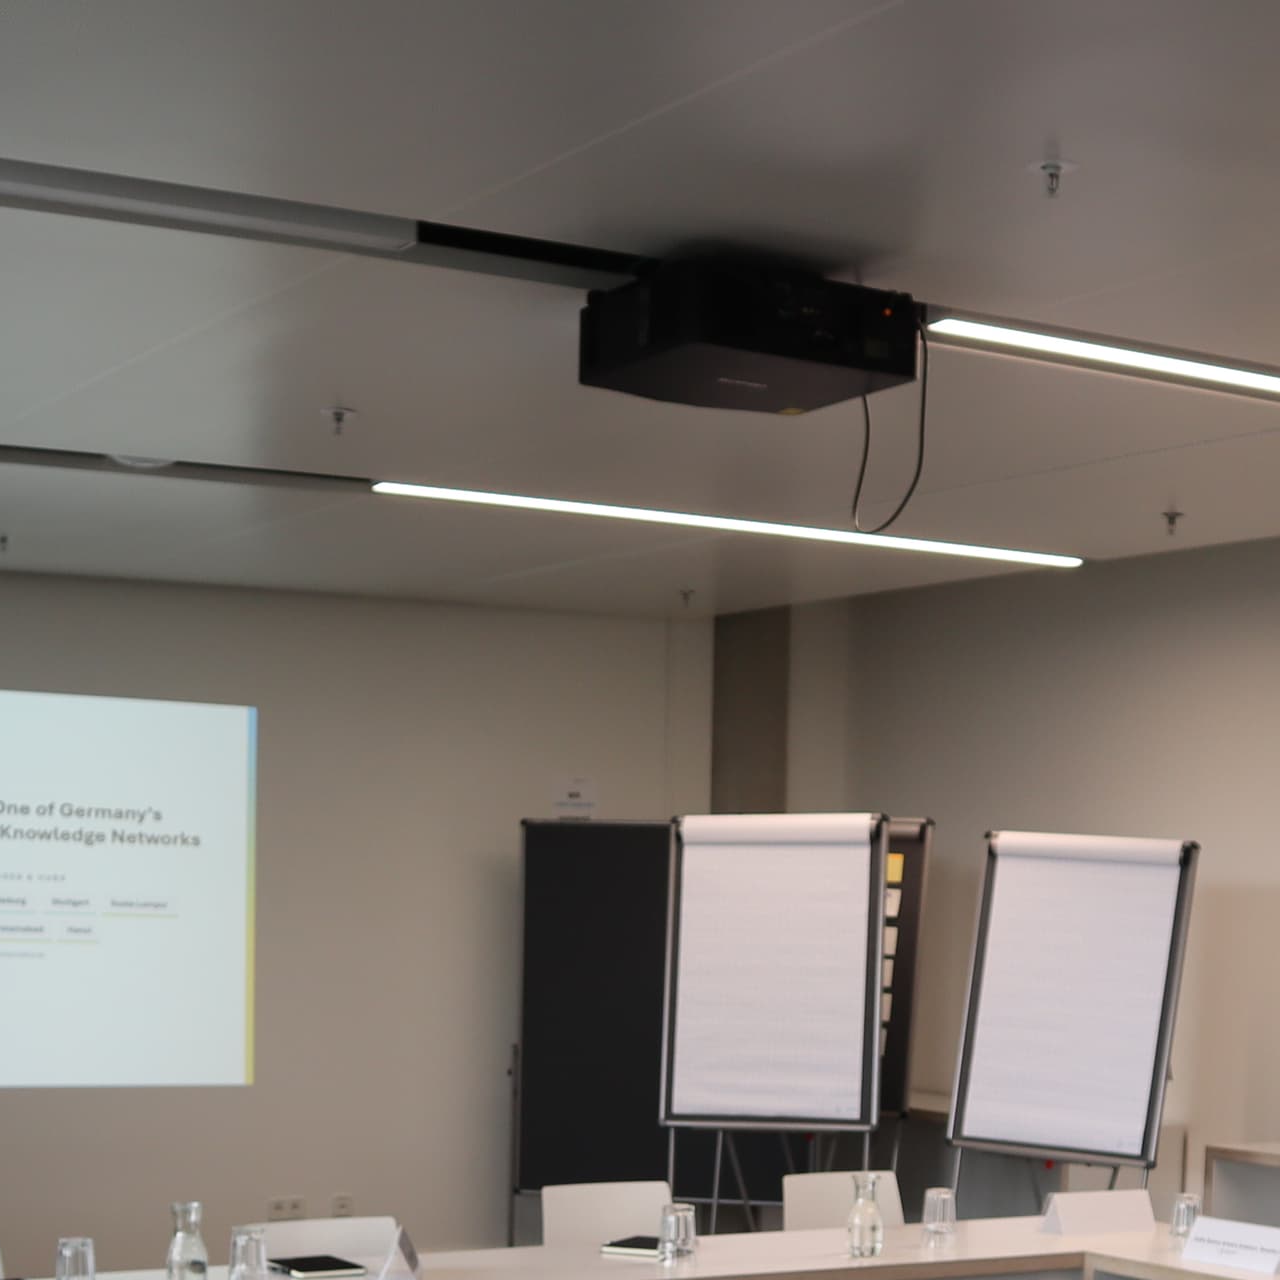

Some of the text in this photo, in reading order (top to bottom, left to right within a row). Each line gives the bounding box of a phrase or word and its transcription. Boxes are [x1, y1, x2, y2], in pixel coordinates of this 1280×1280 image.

[35, 801, 55, 818] of
[59, 803, 163, 824] Germany's
[0, 824, 106, 846] Knowledge
[111, 829, 202, 848] Networks
